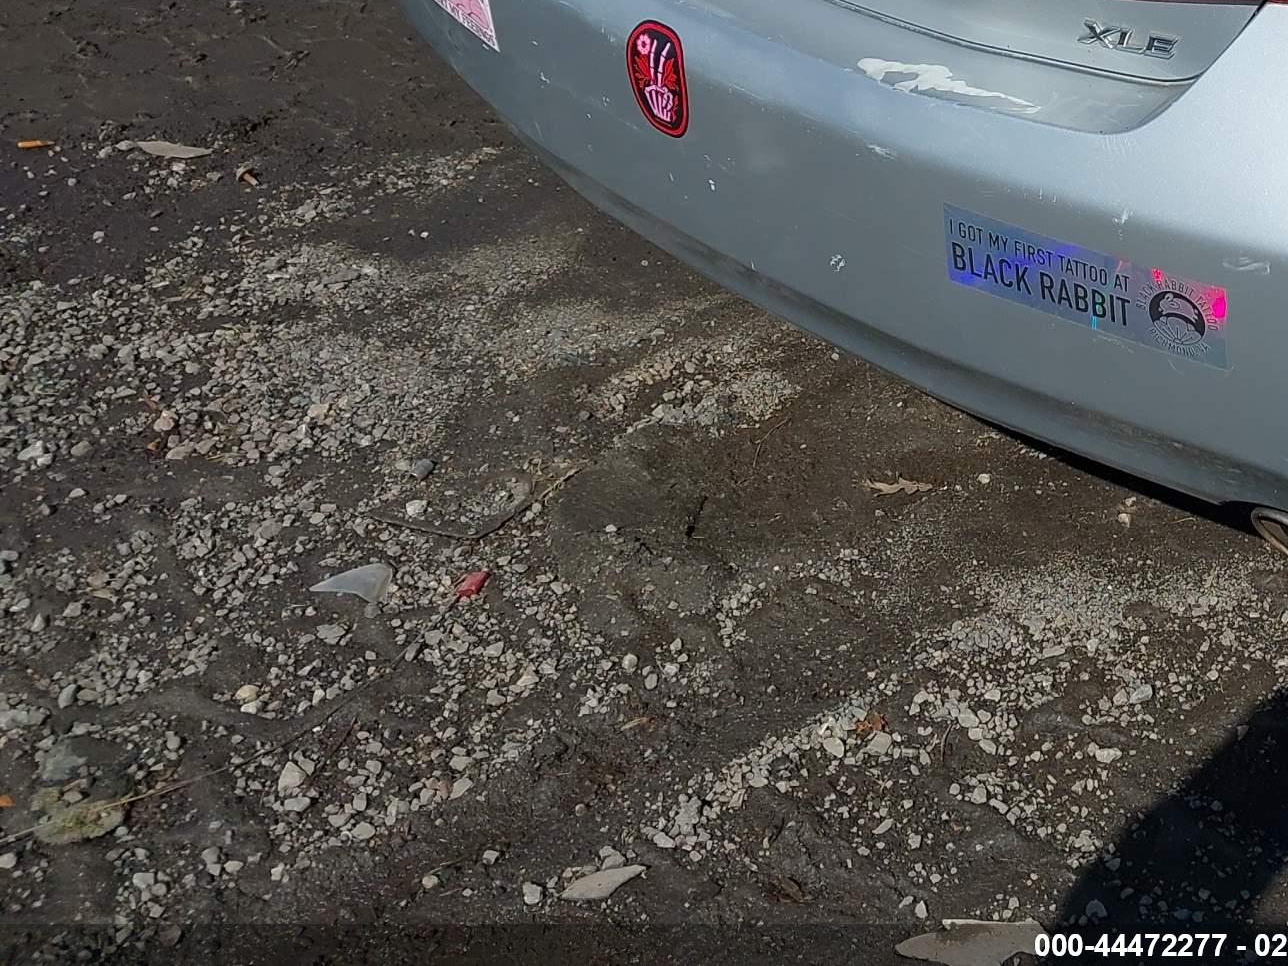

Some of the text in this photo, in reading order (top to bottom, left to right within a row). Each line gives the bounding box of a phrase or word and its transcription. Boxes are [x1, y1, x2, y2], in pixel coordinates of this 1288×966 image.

[1077, 17, 1179, 60] XLE
[948, 218, 1131, 293] I GOT MY FIRST TATTOO AT
[951, 241, 1131, 327] BLACK RABBIT
[1135, 281, 1156, 310] BLACK
[1156, 279, 1195, 298] RABBIT
